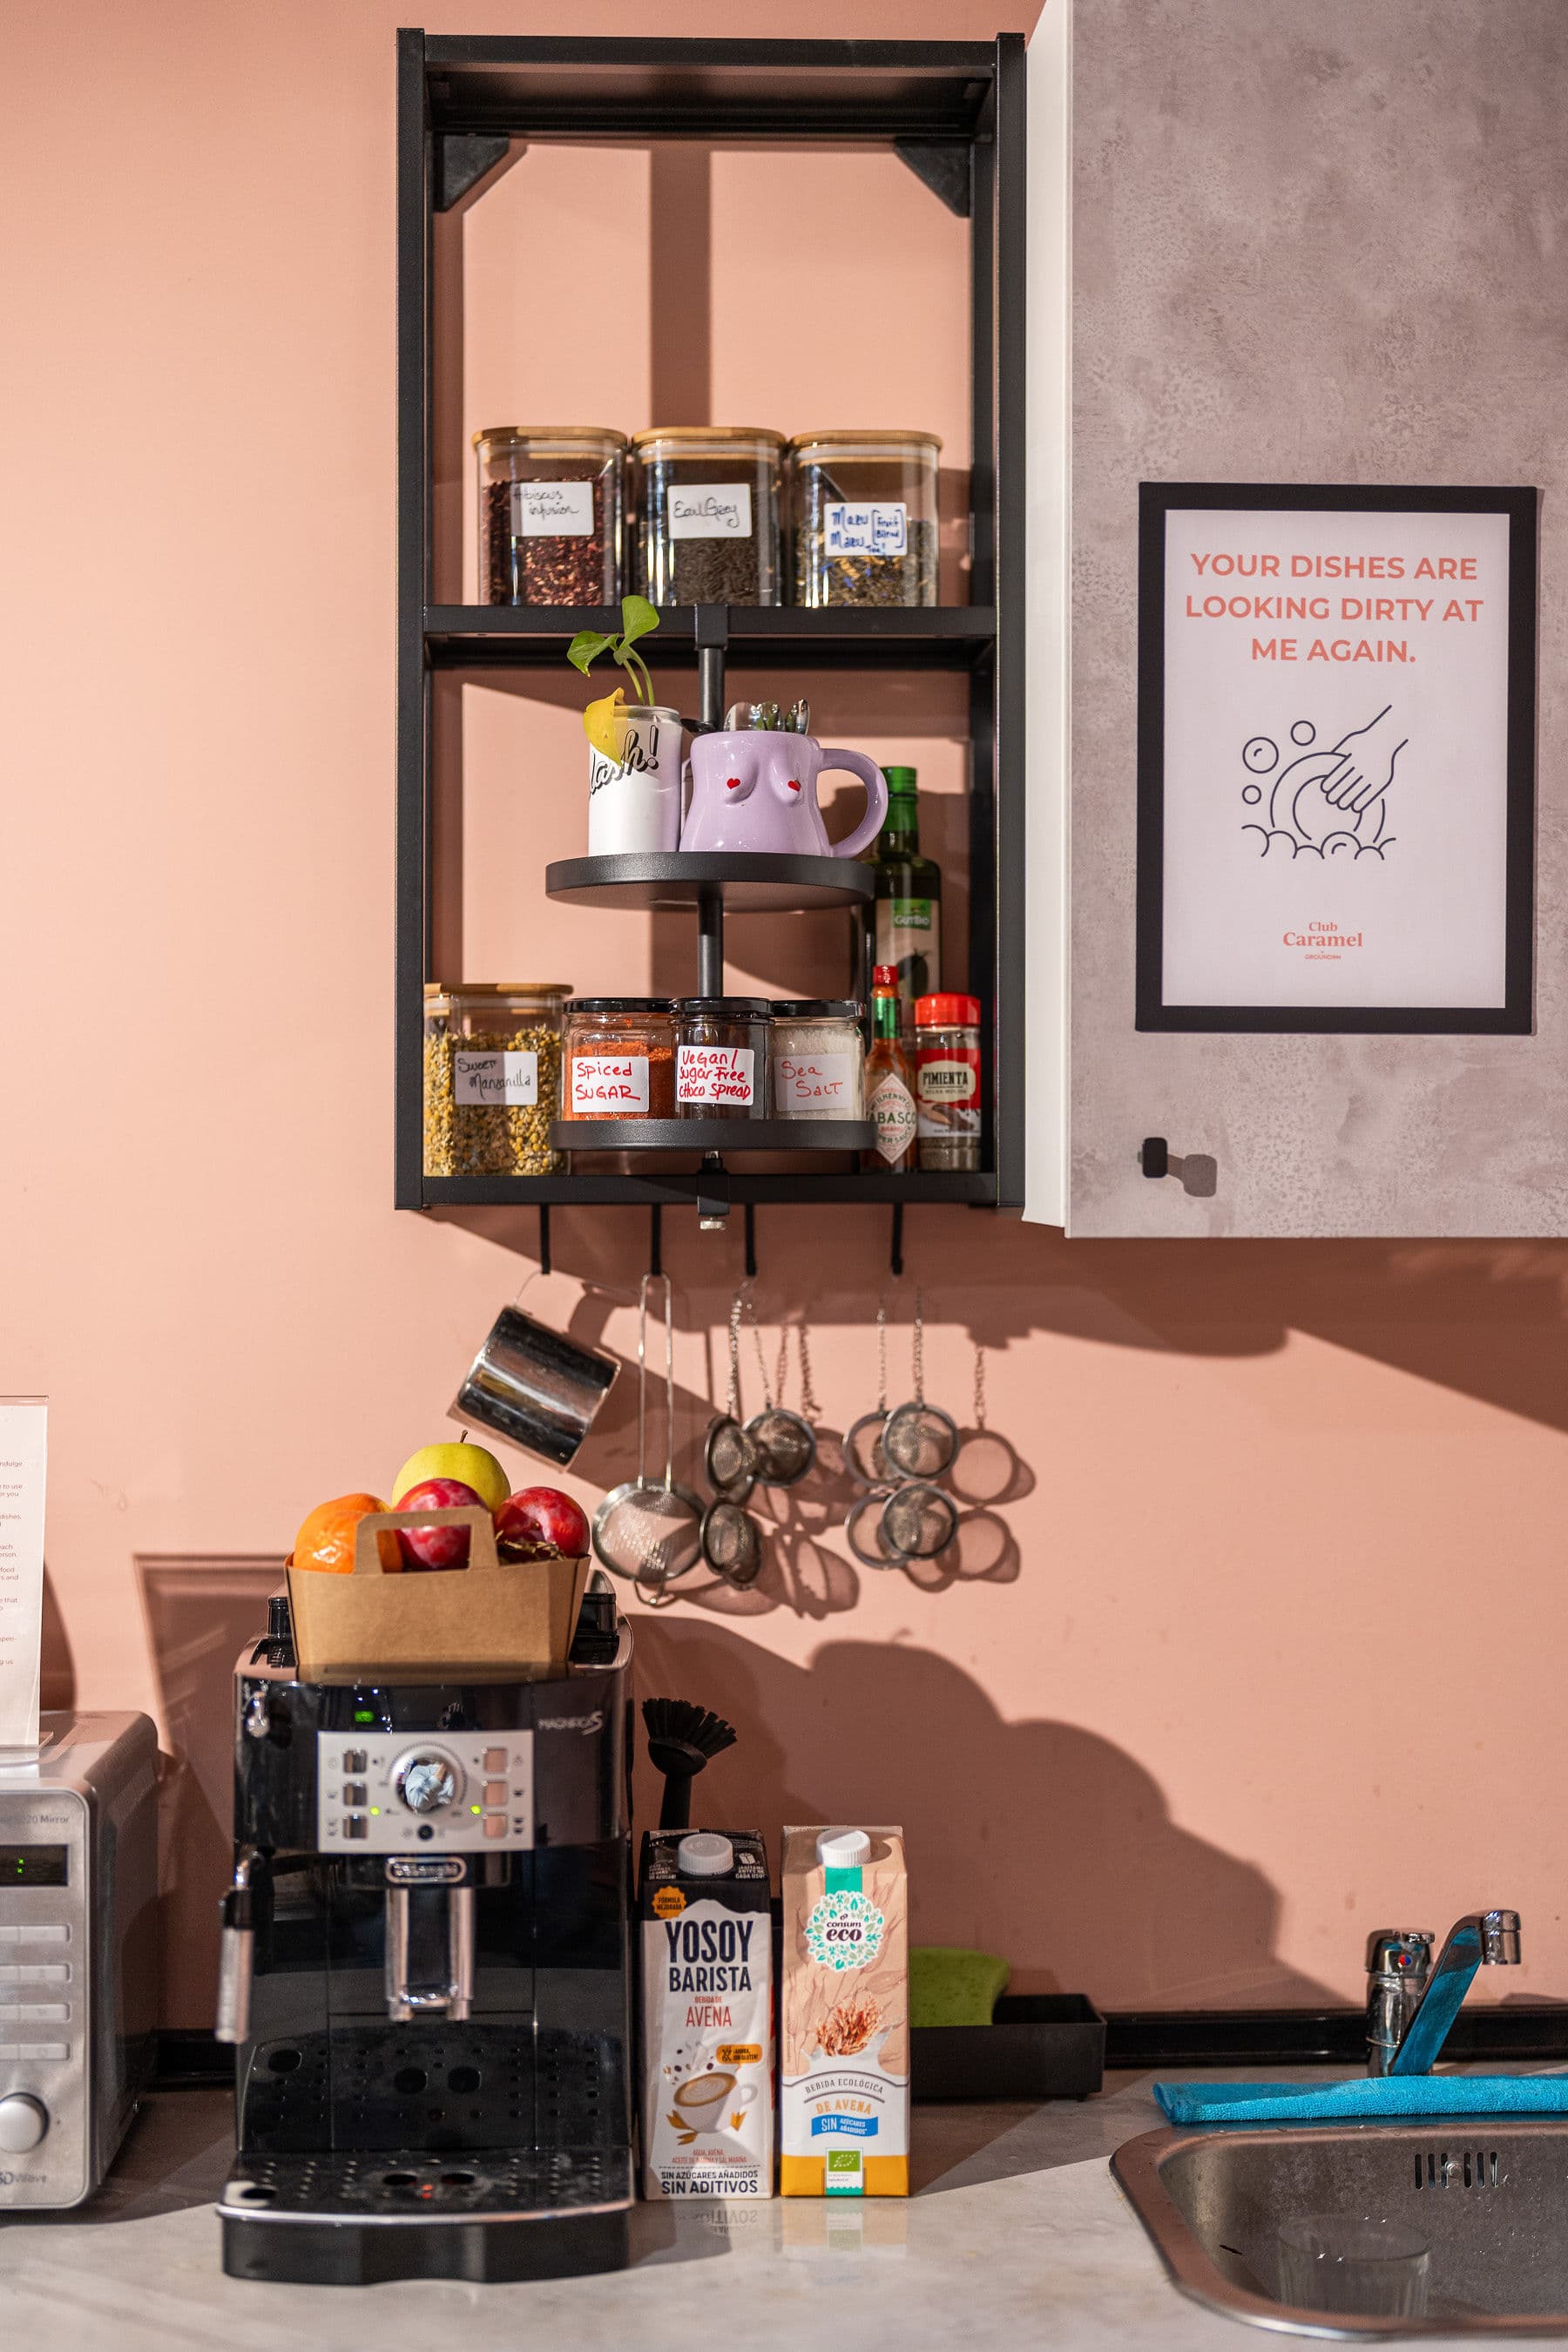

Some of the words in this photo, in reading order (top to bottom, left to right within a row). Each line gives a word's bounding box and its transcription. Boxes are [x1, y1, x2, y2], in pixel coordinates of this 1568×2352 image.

[1191, 554, 1280, 578] YOUR
[1291, 556, 1405, 579] DISHES
[1414, 558, 1477, 580] ARE
[1186, 595, 1330, 619] LOOKING
[1342, 598, 1434, 621] DIRTY
[1443, 599, 1484, 622] AT
[1252, 638, 1297, 661] ME
[1308, 639, 1416, 663] AGAIN.
[1308, 922, 1338, 932] Club
[1282, 932, 1363, 948] Caramel
[577, 1061, 632, 1080] Spiced
[714, 1066, 747, 1083] Free
[781, 1060, 822, 1079] Sea
[923, 1071, 969, 1085] PIMIENTA
[575, 1085, 641, 1100] SUGAR
[40, 1815, 70, 1824] Mirror
[665, 1920, 754, 1963] YOSOY
[826, 1929, 862, 1942] eco
[669, 1966, 752, 1992] BARISTA
[686, 2005, 733, 2027] AVENA
[805, 2079, 835, 2094] BEBIDA
[838, 2078, 883, 2094] ECOLÓGICA
[815, 2100, 831, 2114] DE
[835, 2099, 872, 2114] AVENA
[821, 2117, 837, 2132] SIN
[661, 2171, 674, 2180] SIN
[676, 2169, 718, 2180] AZÚCARES
[719, 2169, 759, 2179] AÑADIDOS
[662, 2180, 686, 2194] SIN
[690, 2180, 759, 2193] ADITIVOS
